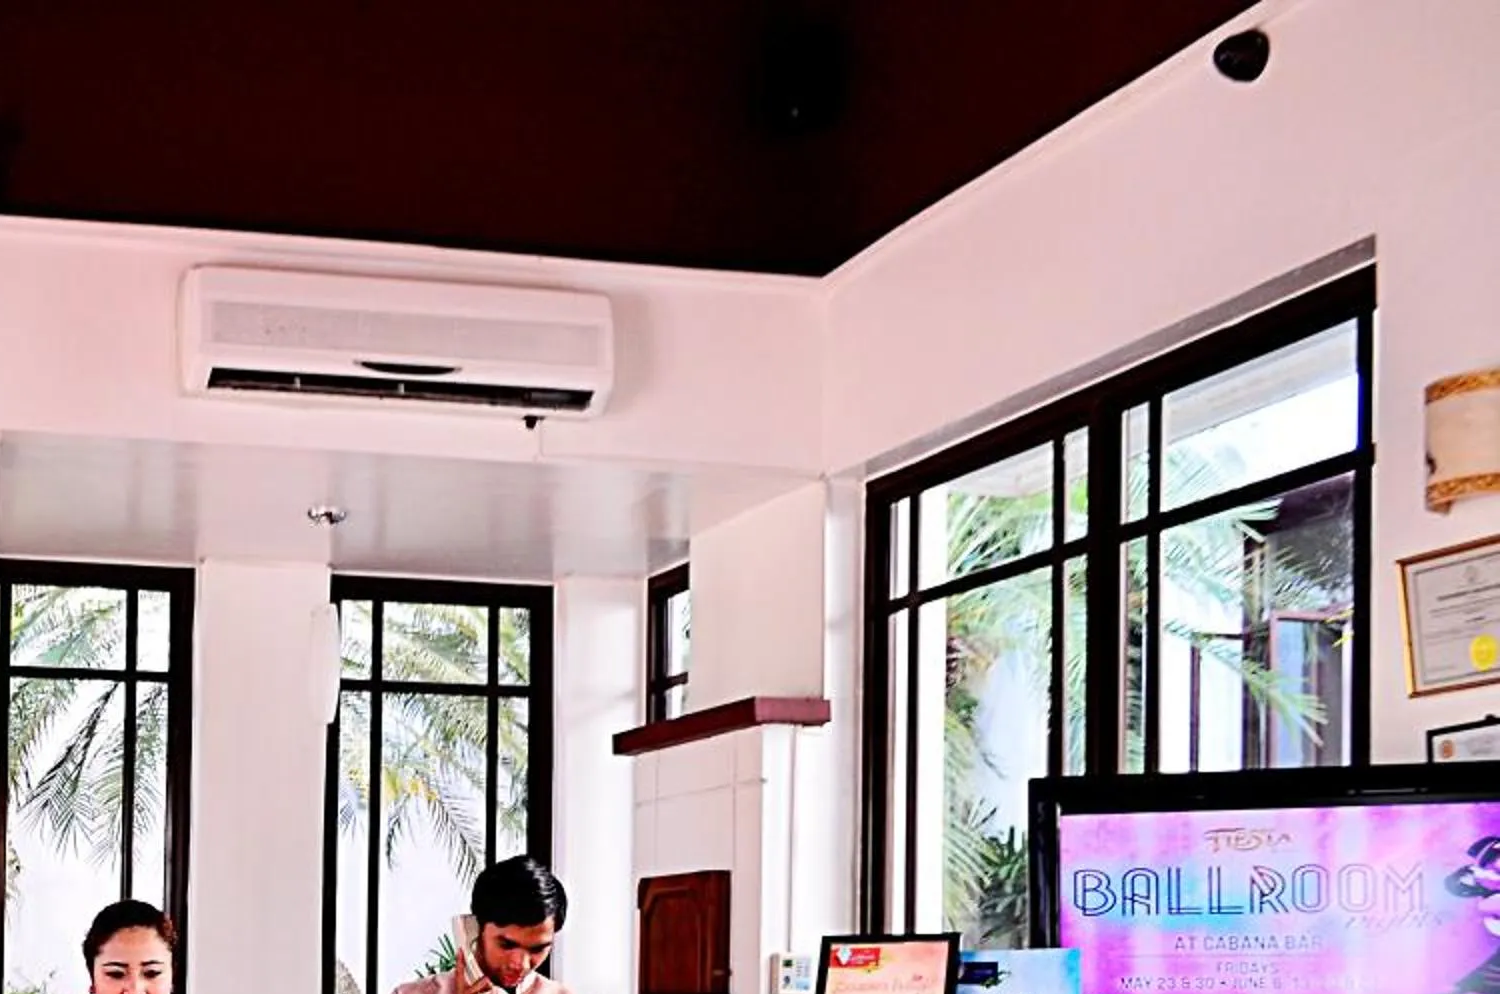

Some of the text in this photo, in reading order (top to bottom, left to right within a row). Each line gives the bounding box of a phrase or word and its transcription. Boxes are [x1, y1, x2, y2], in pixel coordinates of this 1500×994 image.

[1073, 863, 1424, 917] BALLROOM
[1175, 934, 1322, 950] AT CABANA BAR
[1216, 961, 1279, 975] FRIDAYS
[1120, 976, 1151, 990] MAY
[1157, 976, 1177, 991] 23
